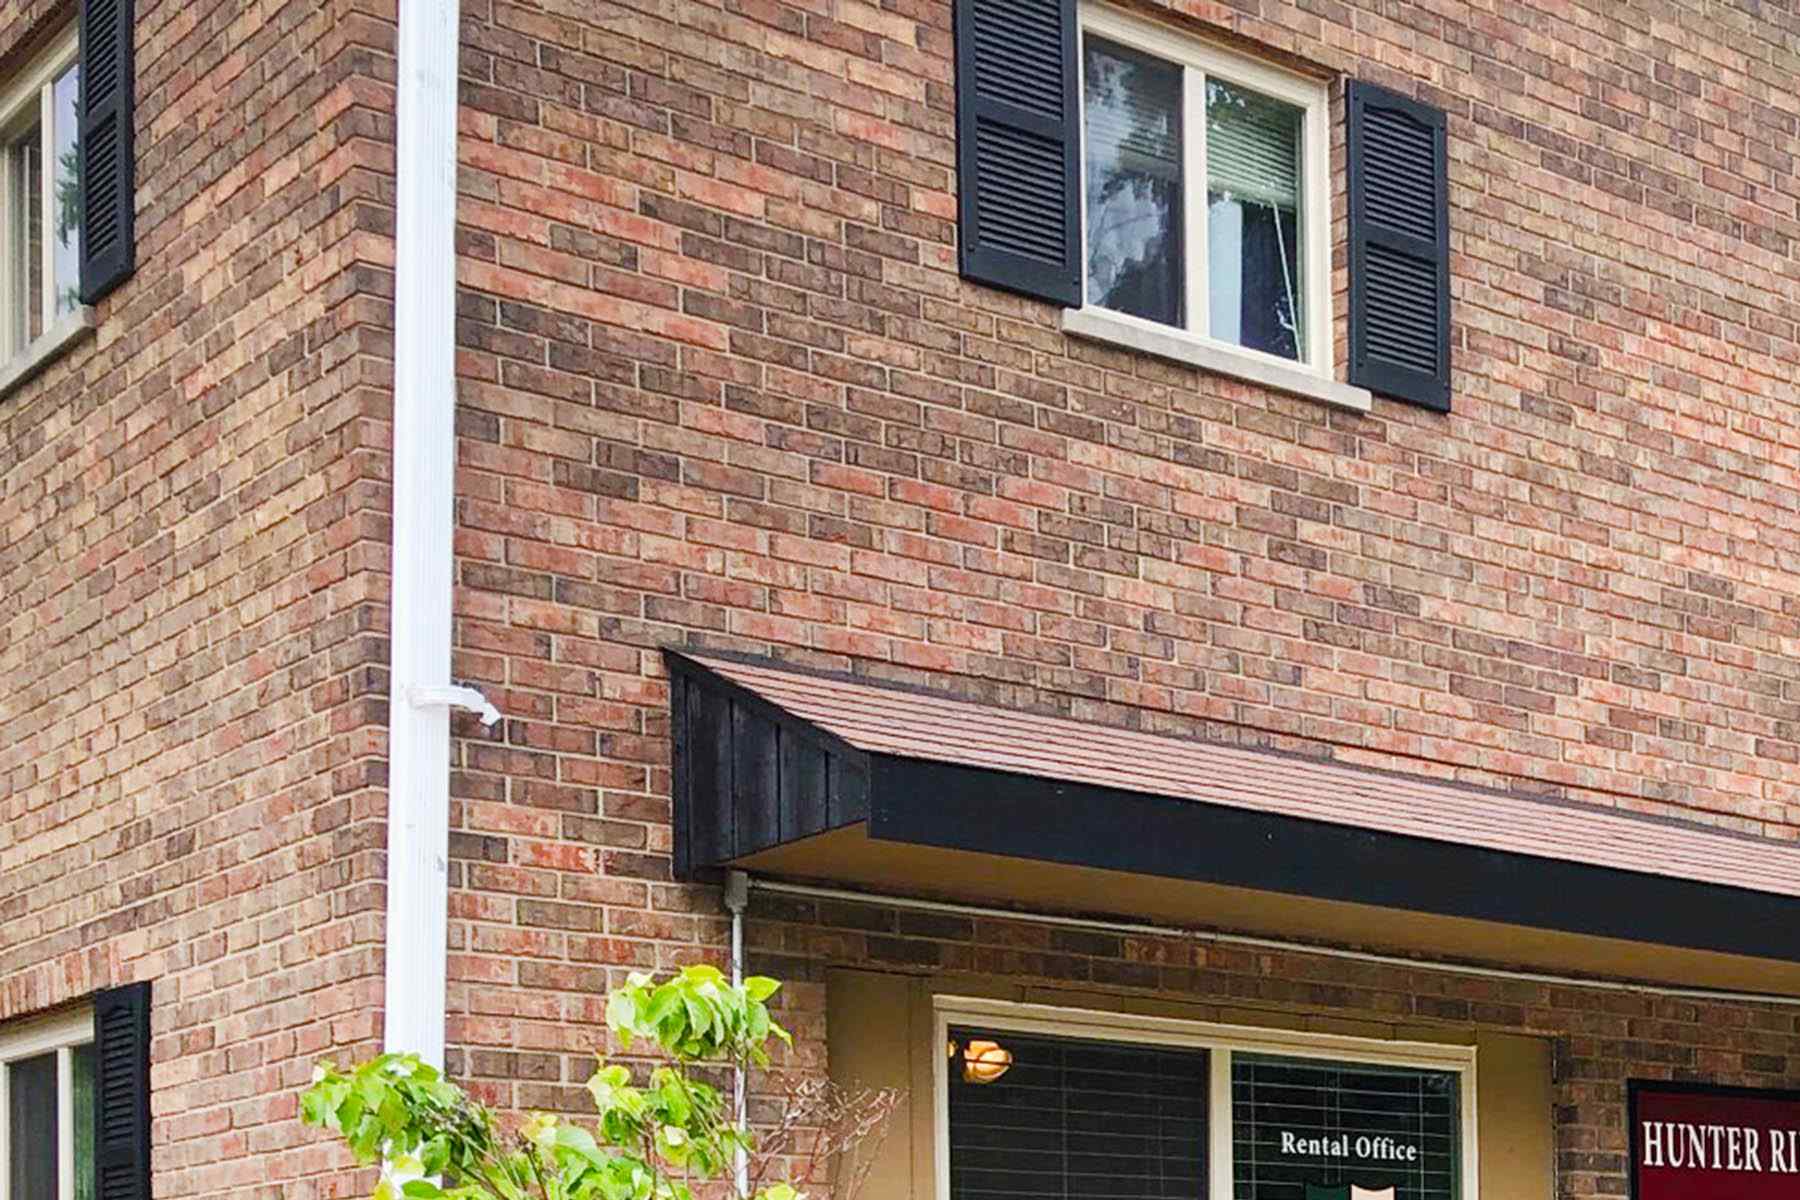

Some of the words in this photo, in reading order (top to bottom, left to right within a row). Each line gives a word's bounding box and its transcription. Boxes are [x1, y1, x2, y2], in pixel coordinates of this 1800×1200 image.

[1281, 1131, 1349, 1157] Rental
[1355, 1136, 1418, 1161] Office
[1642, 1121, 1762, 1173] HUNTER
